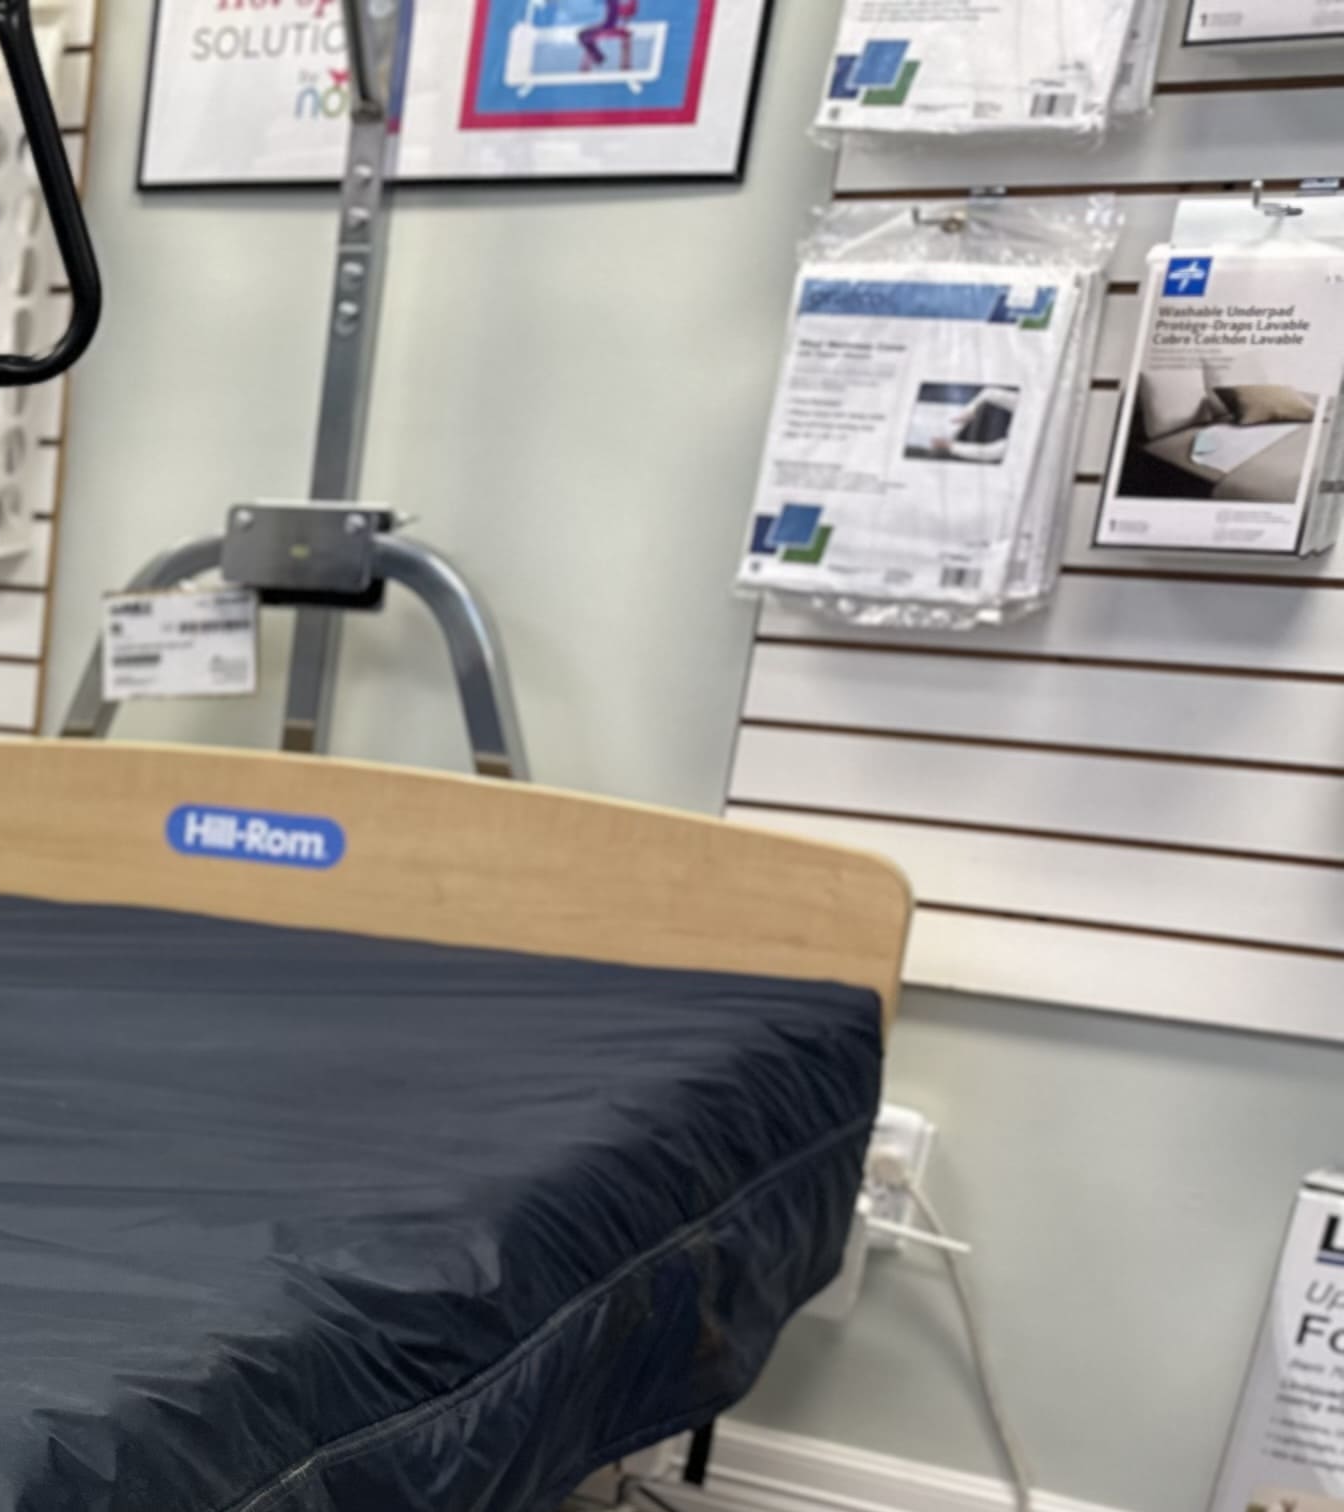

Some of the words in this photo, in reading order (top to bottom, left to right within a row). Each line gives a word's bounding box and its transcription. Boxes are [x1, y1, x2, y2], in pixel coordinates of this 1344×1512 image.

[1158, 305, 1223, 317] Washable
[1227, 305, 1295, 319] Underpad
[1256, 319, 1310, 331] Lavable
[1153, 333, 1191, 345] Cubre
[1251, 333, 1304, 345] Lavable
[184, 811, 326, 860] Hill-Rom
